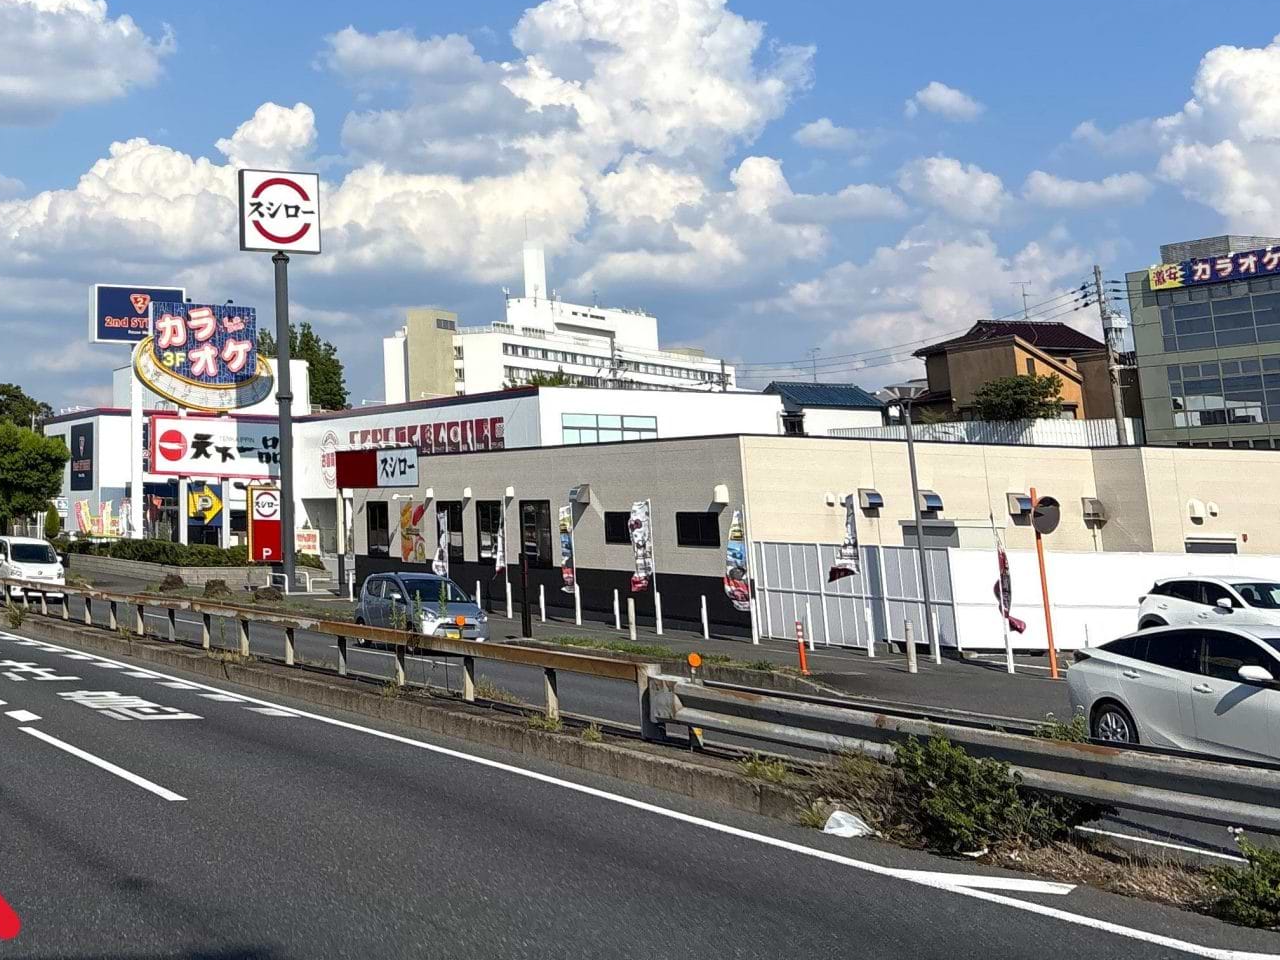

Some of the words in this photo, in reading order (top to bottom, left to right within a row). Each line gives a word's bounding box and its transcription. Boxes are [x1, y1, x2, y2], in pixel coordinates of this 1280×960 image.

[248, 200, 316, 220] スシロー
[1193, 251, 1280, 281] カラオケ
[104, 315, 129, 328] 2nd
[162, 350, 187, 368] 3F
[190, 432, 280, 465] 天下一品
[379, 456, 415, 480] スシロー
[198, 496, 212, 511] P
[262, 547, 272, 559] P
